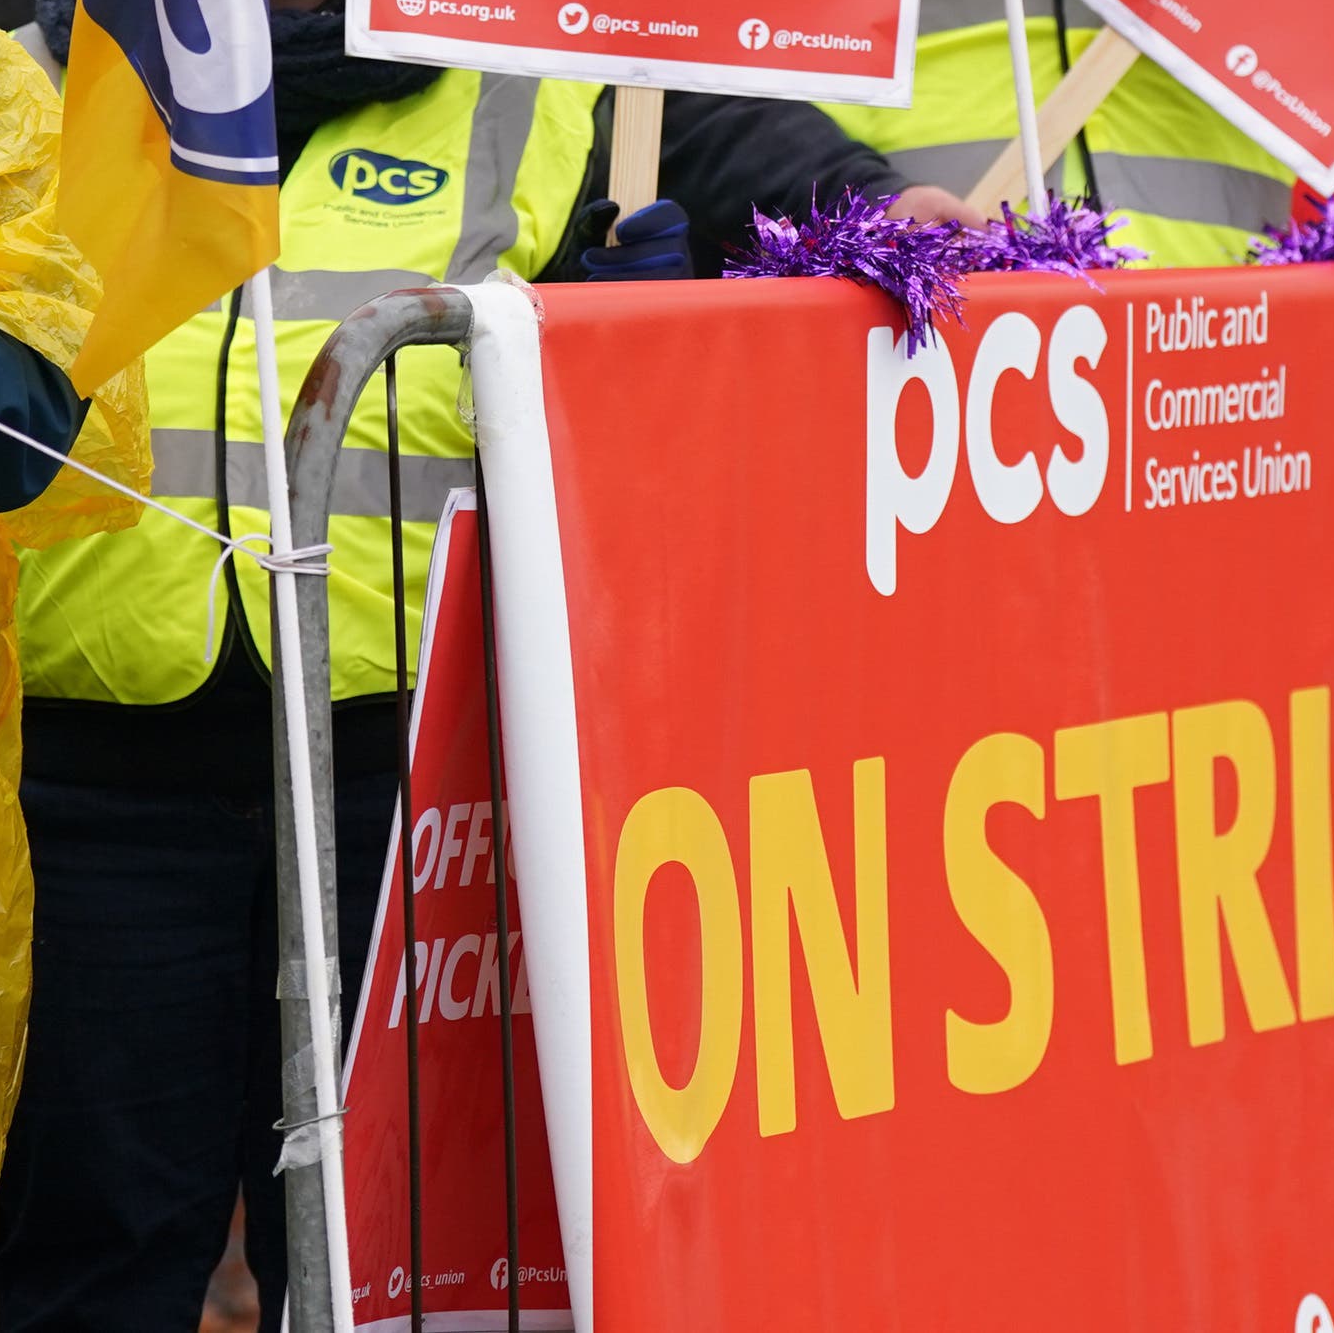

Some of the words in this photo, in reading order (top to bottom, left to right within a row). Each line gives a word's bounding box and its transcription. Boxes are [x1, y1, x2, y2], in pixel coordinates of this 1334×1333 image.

[429, 0, 516, 22] pcs.org.uk
[592, 13, 699, 39] @pcs_union
[772, 29, 873, 53] @PcsUnion
[1250, 69, 1332, 138] @PcsUnion
[341, 154, 438, 197] pcs
[1145, 297, 1216, 354] Public
[1221, 291, 1268, 350] and
[1144, 364, 1287, 432] Commercial
[866, 304, 1109, 597] pcs
[1144, 451, 1238, 510] Services
[1242, 441, 1312, 499] Union
[388, 931, 533, 1029] PICK
[614, 756, 895, 1164] ON
[404, 1268, 466, 1294] @cs_union
